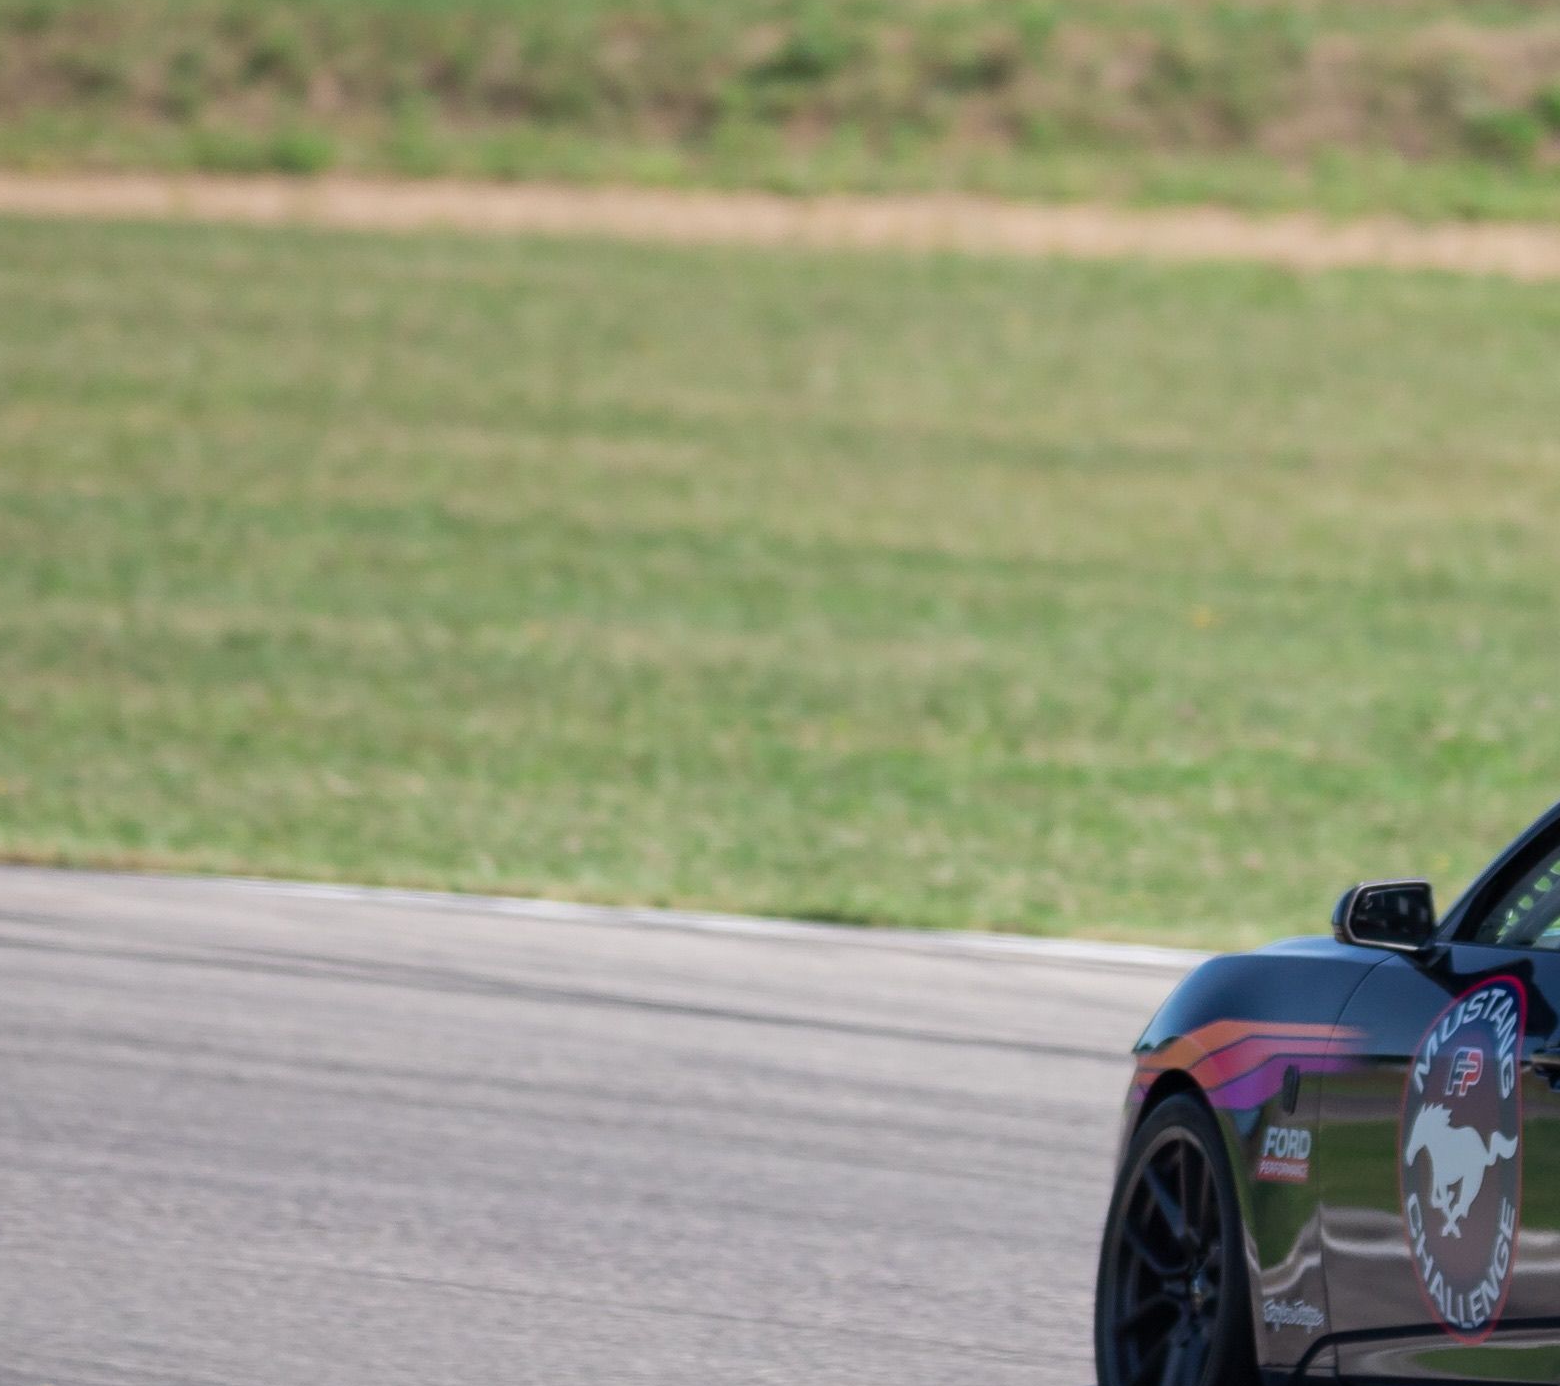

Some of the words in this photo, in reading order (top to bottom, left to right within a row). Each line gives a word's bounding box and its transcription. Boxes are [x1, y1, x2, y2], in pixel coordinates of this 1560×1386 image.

[1413, 988, 1520, 1100] MUSTANG
[1263, 1124, 1312, 1160] FORD
[1407, 1192, 1517, 1330] CHALLENGE
